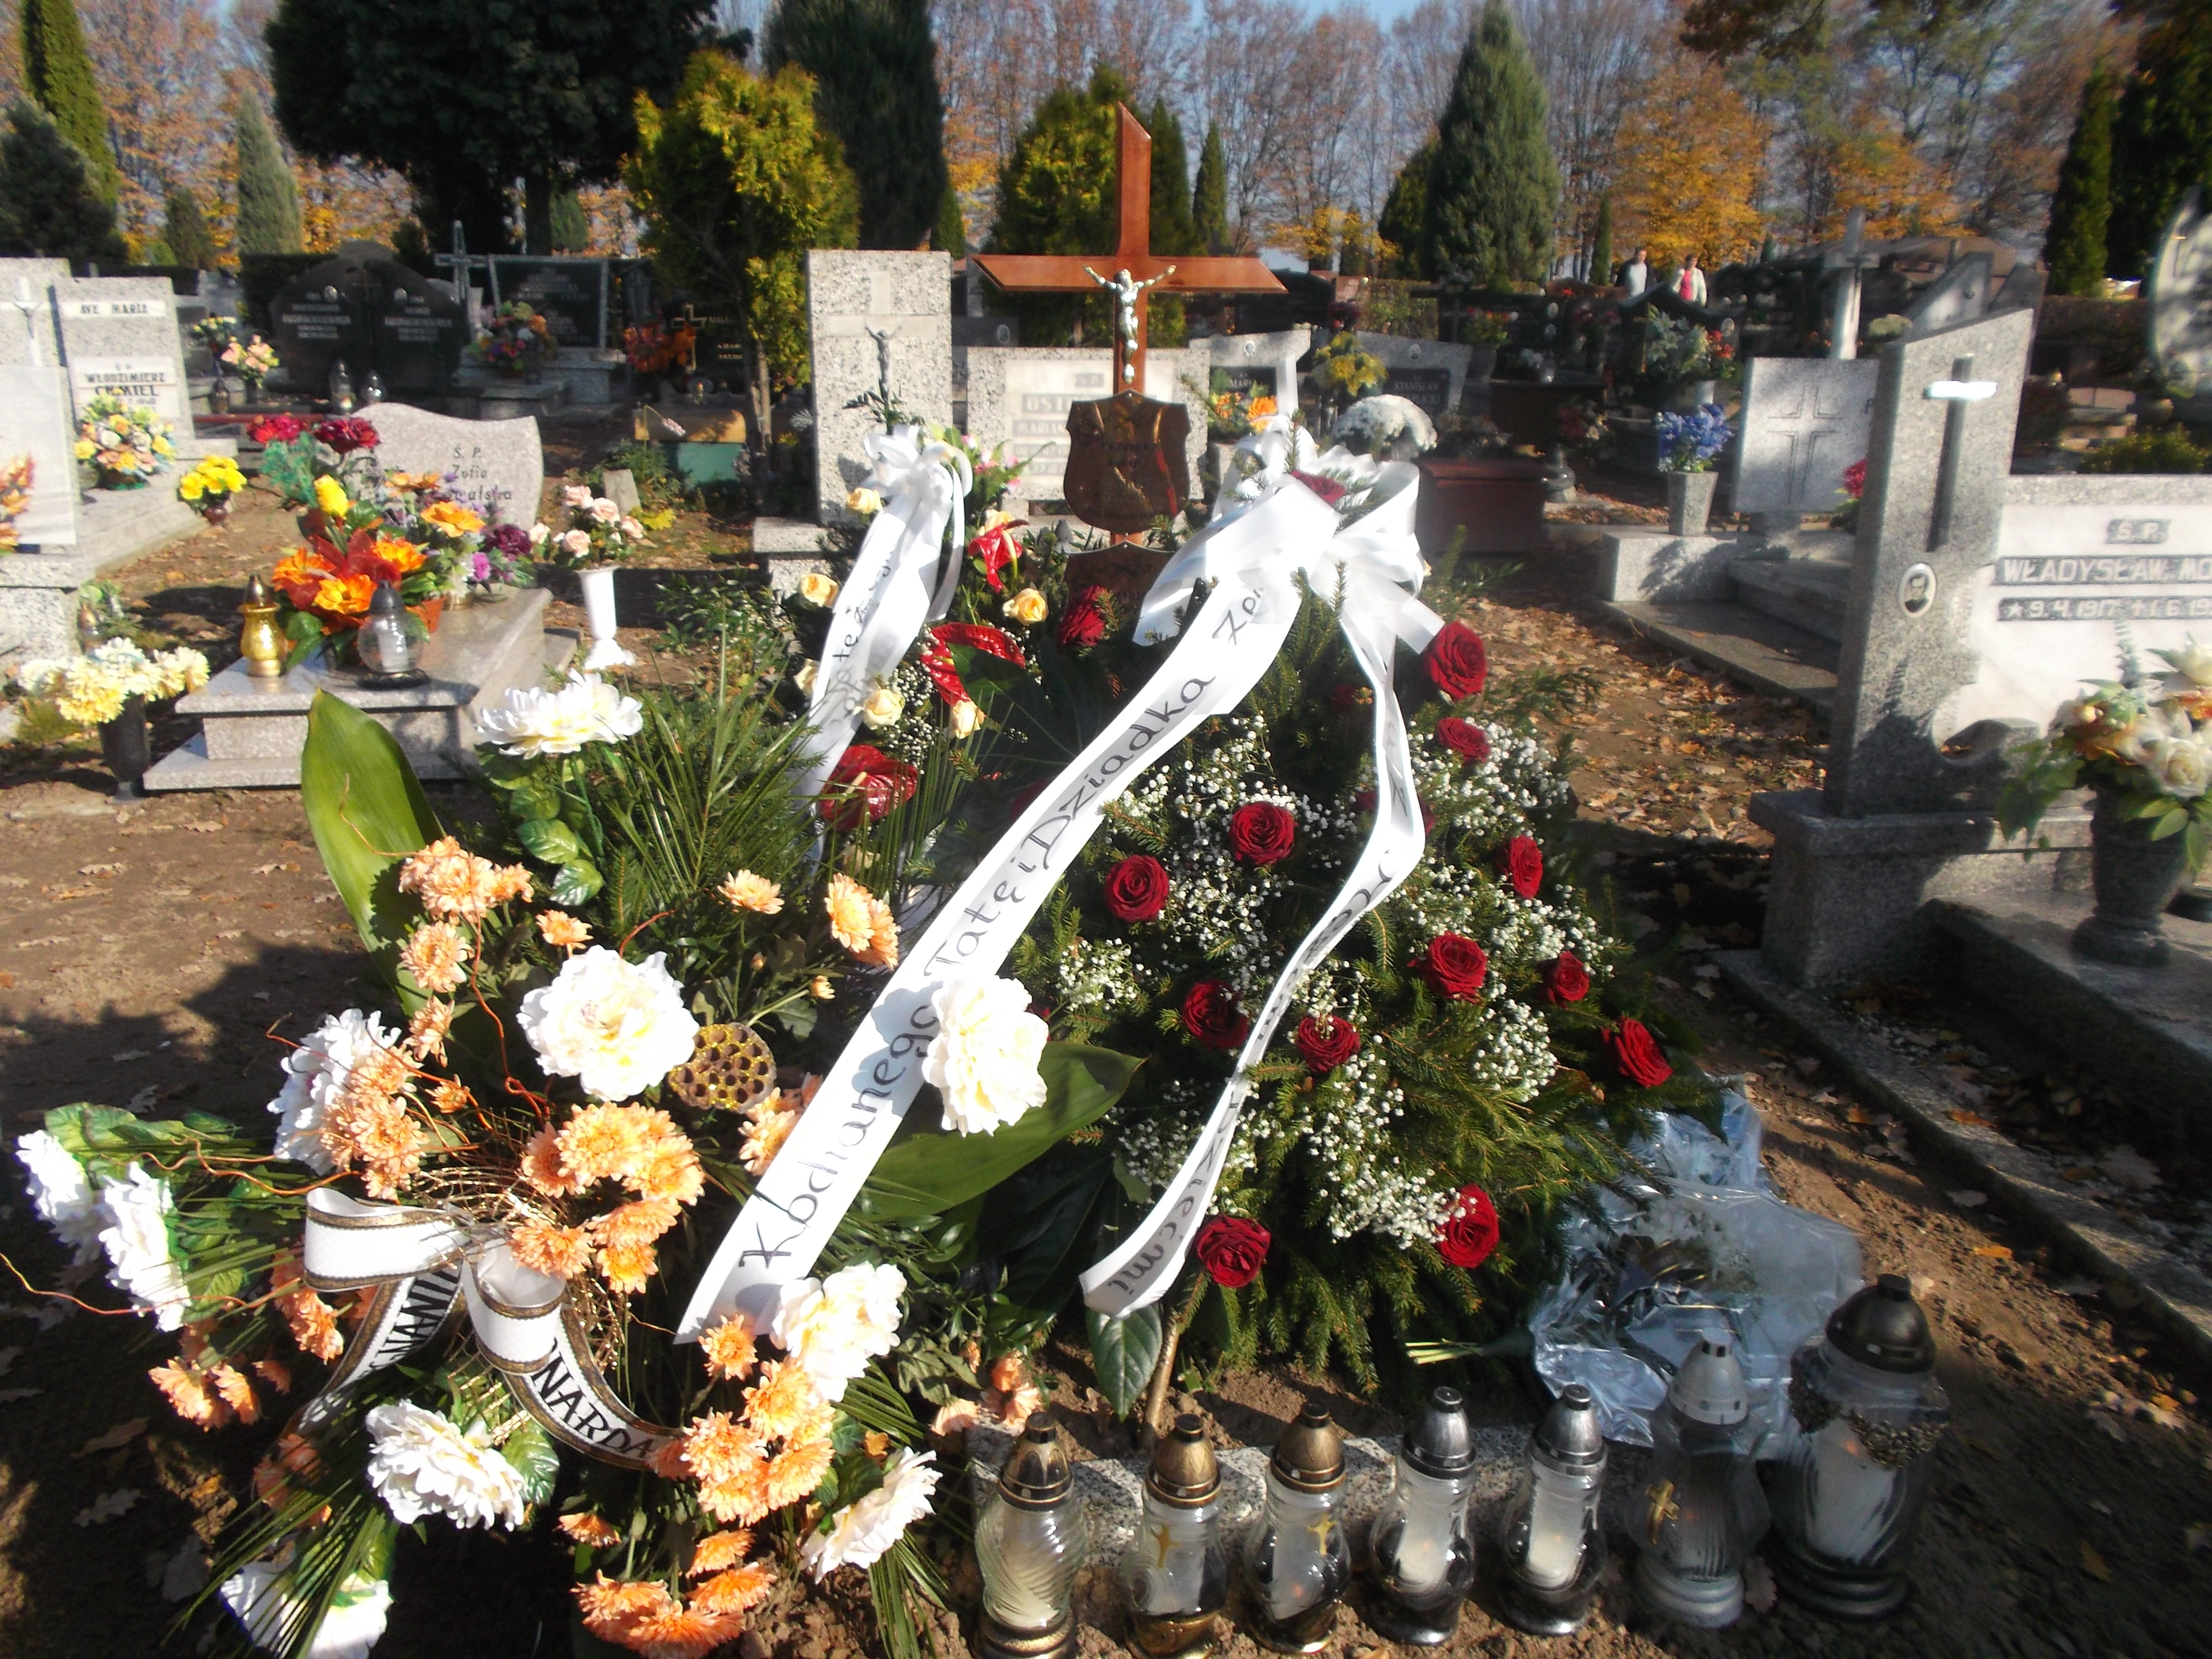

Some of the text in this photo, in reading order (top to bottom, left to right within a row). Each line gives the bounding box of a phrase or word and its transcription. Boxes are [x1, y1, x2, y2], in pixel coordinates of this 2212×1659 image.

[80, 303, 148, 314] AVE MARIA
[2004, 558, 2168, 582] WŁADYSŁAW
[923, 880, 1027, 977] Tatę
[1019, 675, 1217, 871] Dziadka
